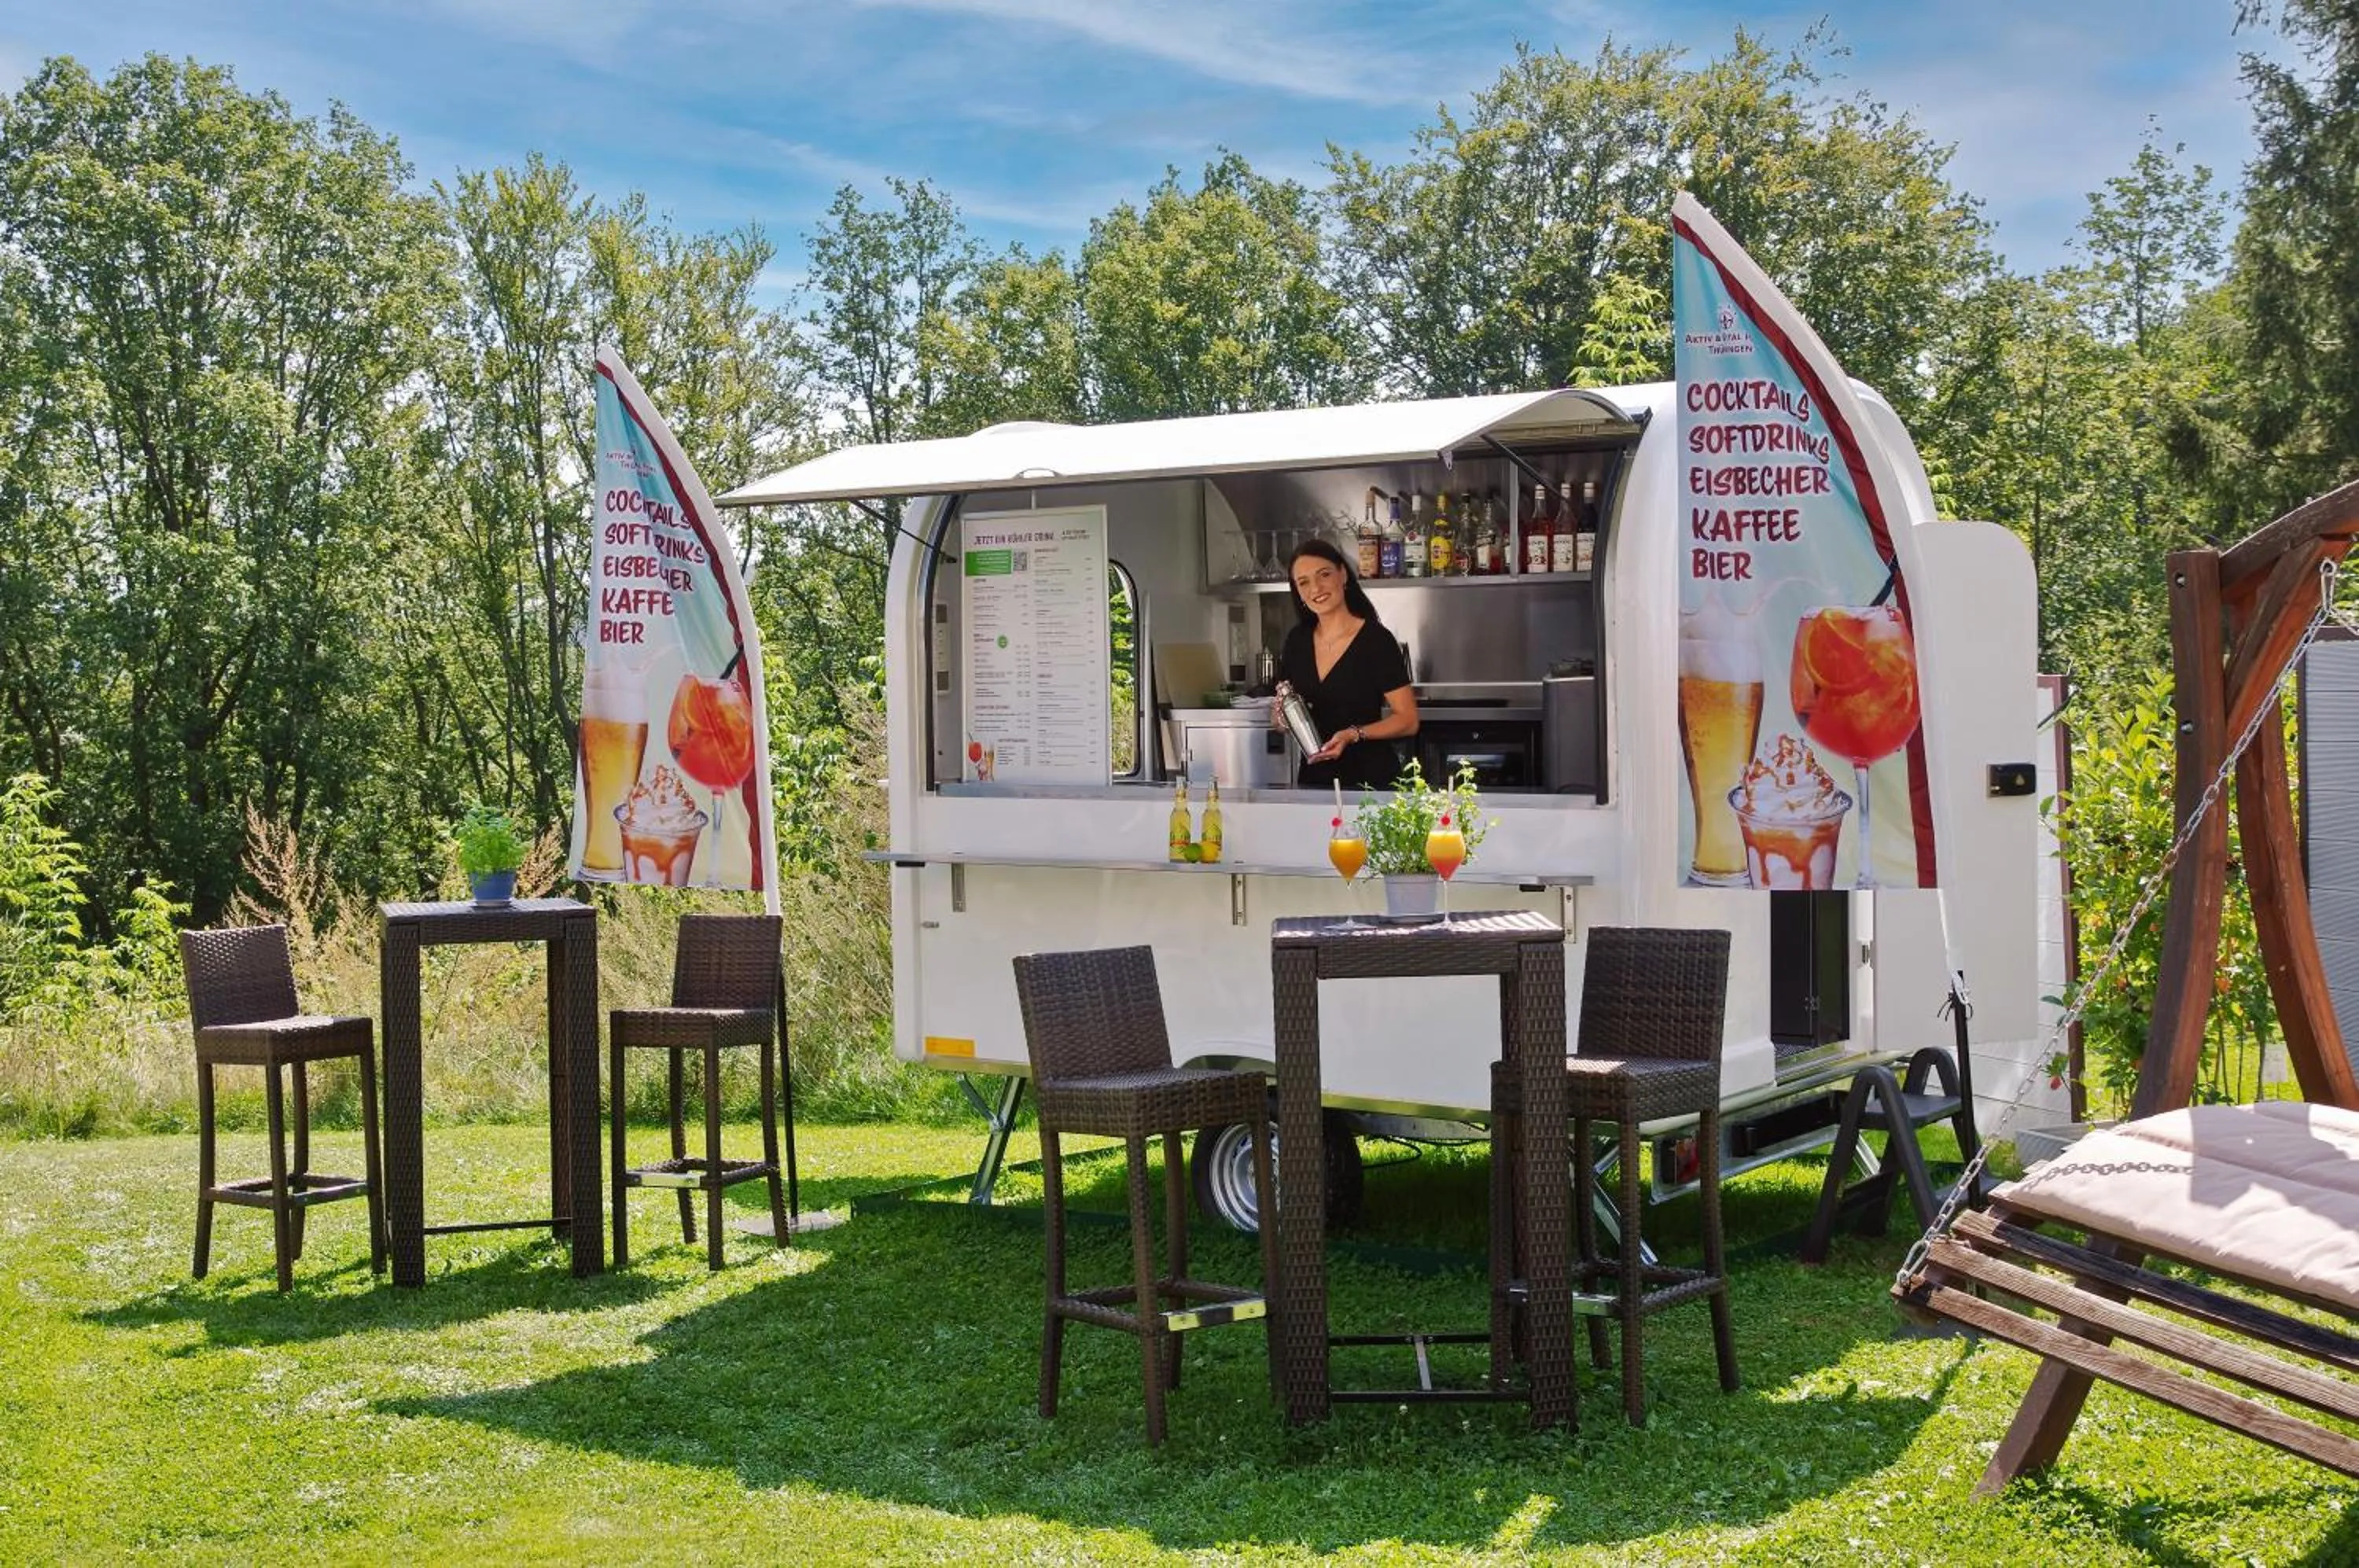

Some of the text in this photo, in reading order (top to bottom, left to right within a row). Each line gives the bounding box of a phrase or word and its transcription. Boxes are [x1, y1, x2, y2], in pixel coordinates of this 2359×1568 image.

[1687, 381, 1809, 422] COCKTAILS
[1690, 425, 1829, 464] SOFTDRINKS
[1691, 466, 1831, 496] EISBECHER
[605, 490, 691, 530] COCTAILS
[1691, 508, 1801, 542] KAFFEE
[604, 523, 705, 564] SOFTRINKS
[1691, 548, 1753, 580] BIER
[600, 620, 645, 644] BIER
